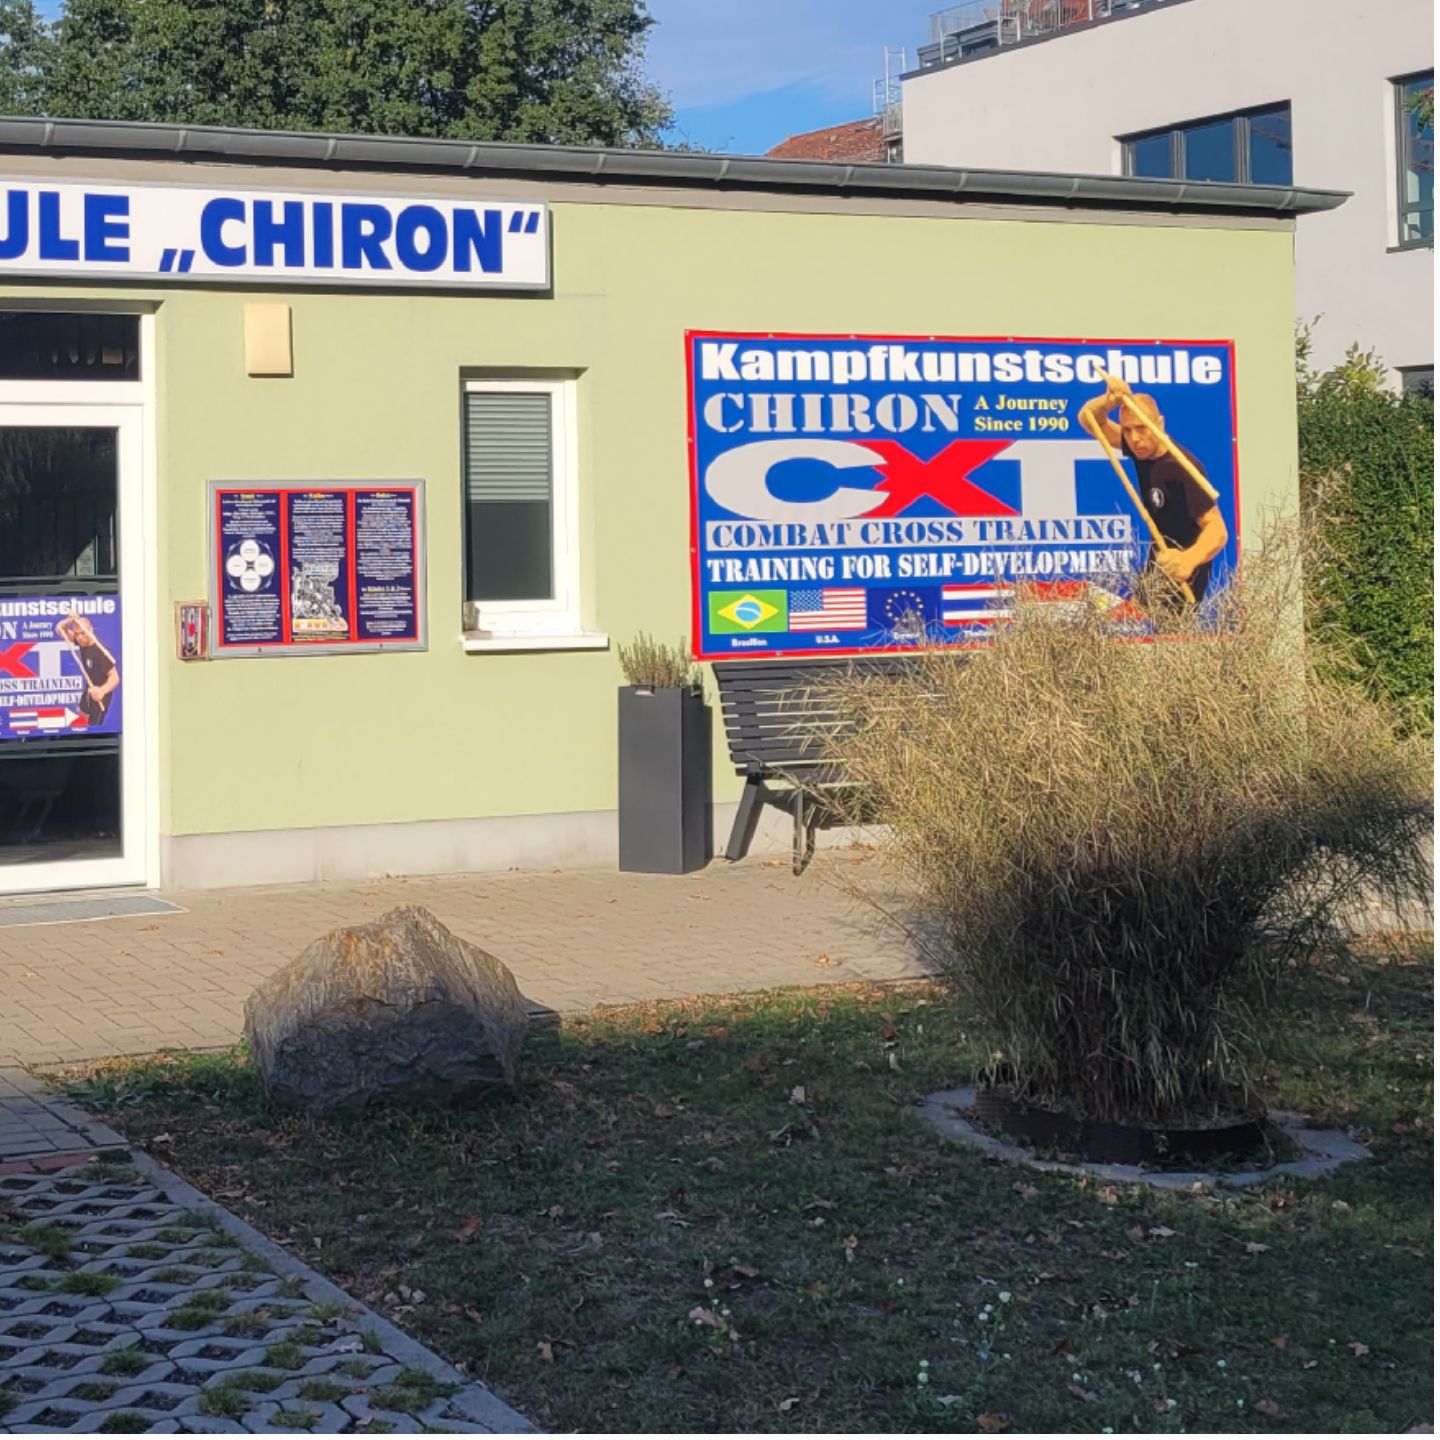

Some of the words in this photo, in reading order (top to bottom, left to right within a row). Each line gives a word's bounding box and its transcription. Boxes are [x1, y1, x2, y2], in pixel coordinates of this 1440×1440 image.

[701, 343, 1223, 386] Kampfkunstschule
[704, 392, 962, 434] CHIRON
[973, 396, 990, 411] A
[995, 394, 1070, 415] Journey
[974, 415, 1024, 433] Since
[1027, 417, 1070, 433] 1990
[704, 438, 1130, 520] CXT
[711, 523, 852, 549] COMBAT
[860, 520, 965, 546] CROSS
[972, 518, 1128, 543] TRAINING
[707, 556, 835, 582] TRAINING
[841, 554, 893, 580] FOR
[898, 549, 1134, 579] SELF-DEVELOPMENT
[21, 676, 82, 691] TRAINING
